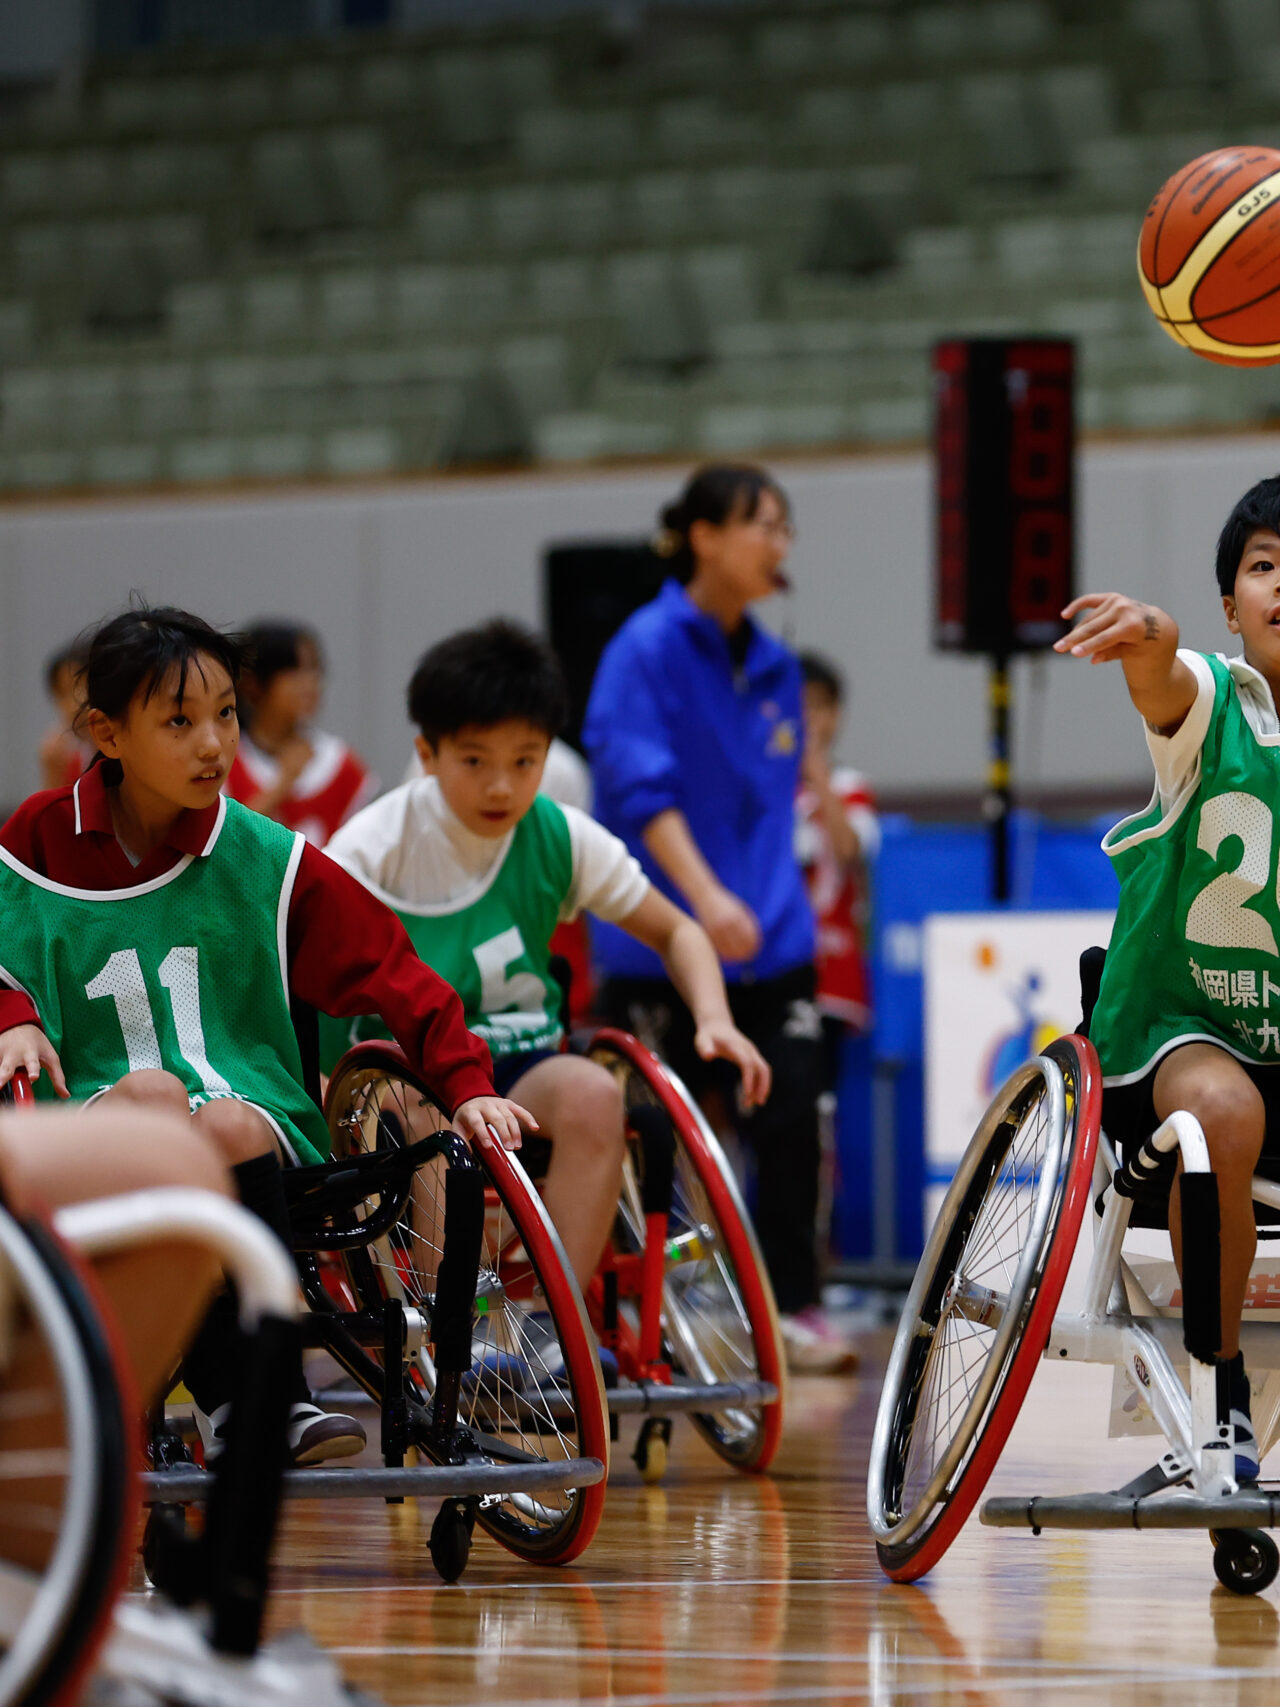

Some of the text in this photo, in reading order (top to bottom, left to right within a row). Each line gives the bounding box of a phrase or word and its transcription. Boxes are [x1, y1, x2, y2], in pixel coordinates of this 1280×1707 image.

[1238, 189, 1271, 216] GJ5
[84, 946, 232, 1089] 11
[472, 925, 548, 1030] 5
